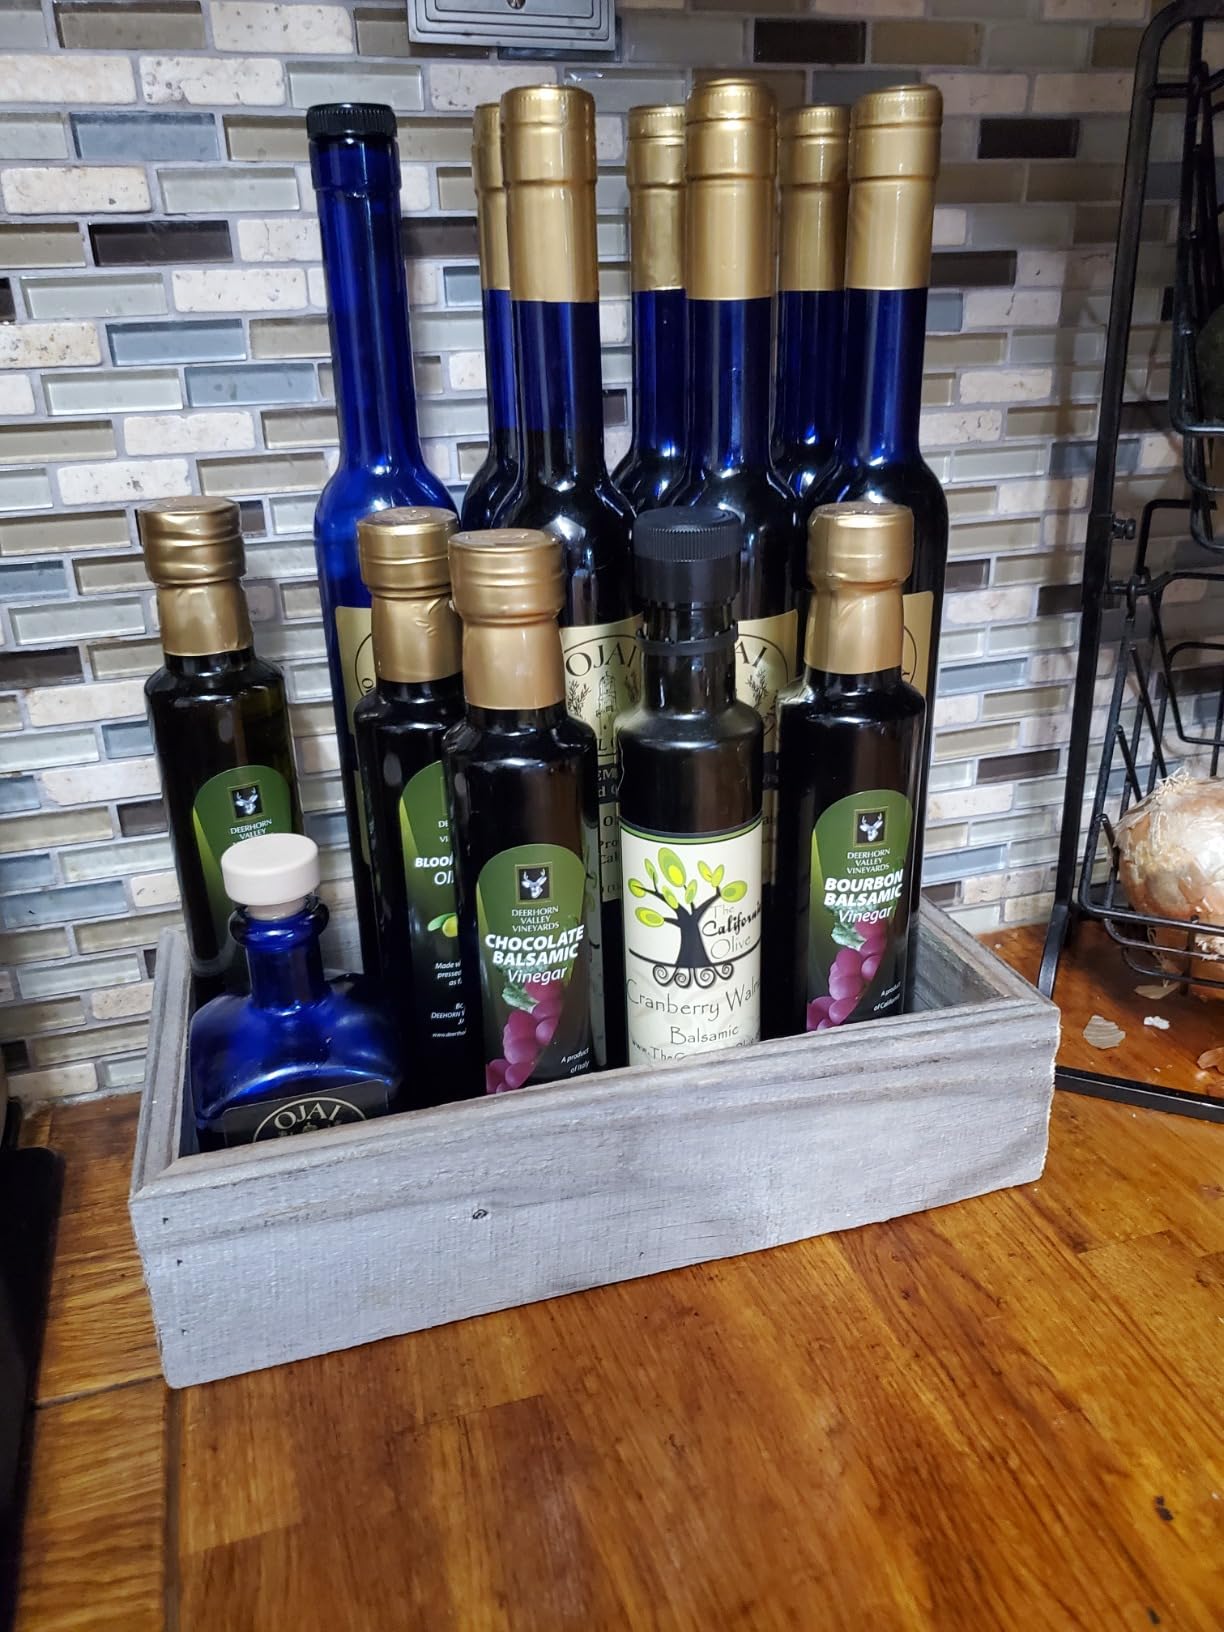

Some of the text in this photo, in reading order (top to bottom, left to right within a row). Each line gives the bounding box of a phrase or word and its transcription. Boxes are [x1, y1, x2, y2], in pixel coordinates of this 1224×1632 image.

[565, 642, 637, 677] OJAI
[230, 818, 272, 835] DEERHORN
[848, 848, 891, 859] DEERHORN
[855, 857, 884, 866] VALLEY
[846, 863, 890, 874] VINEYARDS
[824, 868, 904, 892] BOURBON
[823, 883, 903, 907] BALSAMIC
[511, 905, 559, 917] DEERHORN
[520, 914, 551, 925] VALLEY
[838, 906, 893, 925] Vinegar
[512, 921, 560, 933] VINEYARDS
[484, 924, 585, 951] CHOCOLATE
[711, 935, 751, 960] Olive
[492, 943, 579, 967] BALSAMIC
[507, 966, 567, 986] Vinegar
[627, 978, 719, 1022] Cranberry
[670, 1024, 738, 1045] Balsamic
[566, 1047, 590, 1063] product
[274, 1102, 341, 1129] OJAI
